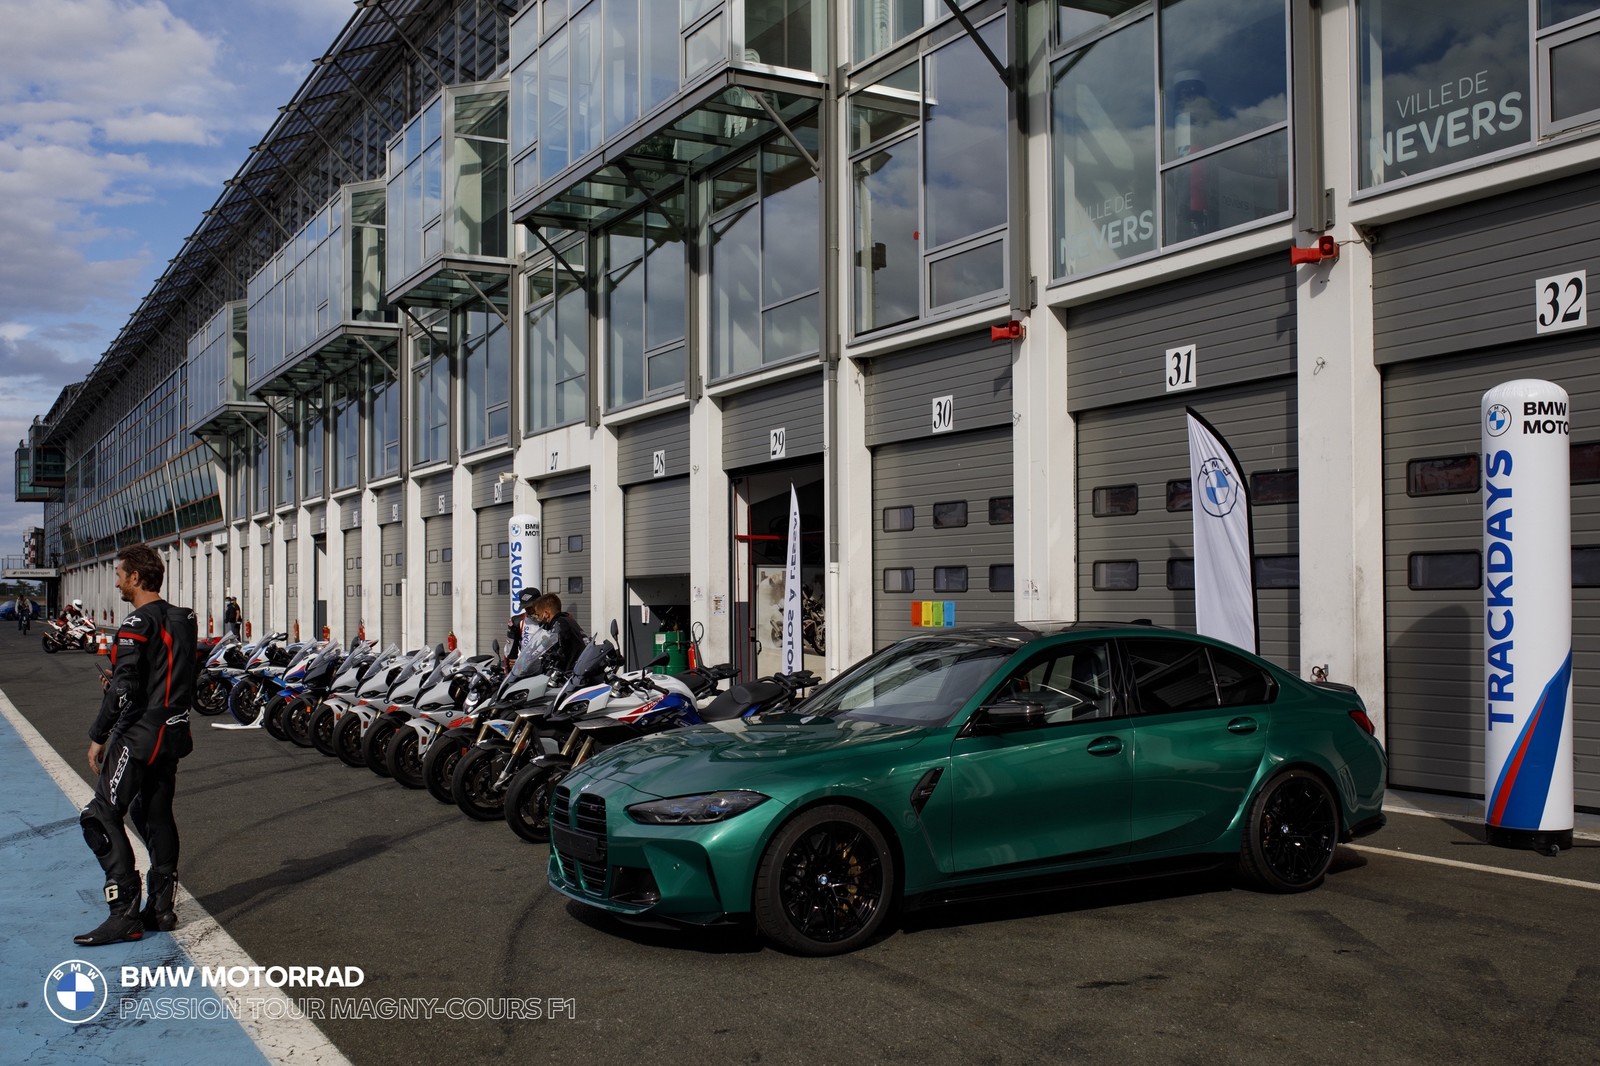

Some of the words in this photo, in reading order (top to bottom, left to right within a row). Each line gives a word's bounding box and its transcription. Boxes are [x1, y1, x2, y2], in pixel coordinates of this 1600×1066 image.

[1396, 82, 1453, 119] VILLE
[1458, 70, 1489, 99] DE
[1369, 91, 1524, 170] NEVERS
[1114, 191, 1134, 214] DE
[1538, 276, 1584, 327] 32
[1168, 349, 1193, 387] 31
[933, 398, 952, 430] 30
[1523, 401, 1567, 416] BMW
[771, 430, 785, 456] 29
[550, 451, 559, 471] 27
[654, 452, 665, 474] 28
[510, 541, 523, 614] CKDAYS
[1486, 449, 1515, 731] TRACKDAYS
[104, 884, 119, 903] G
